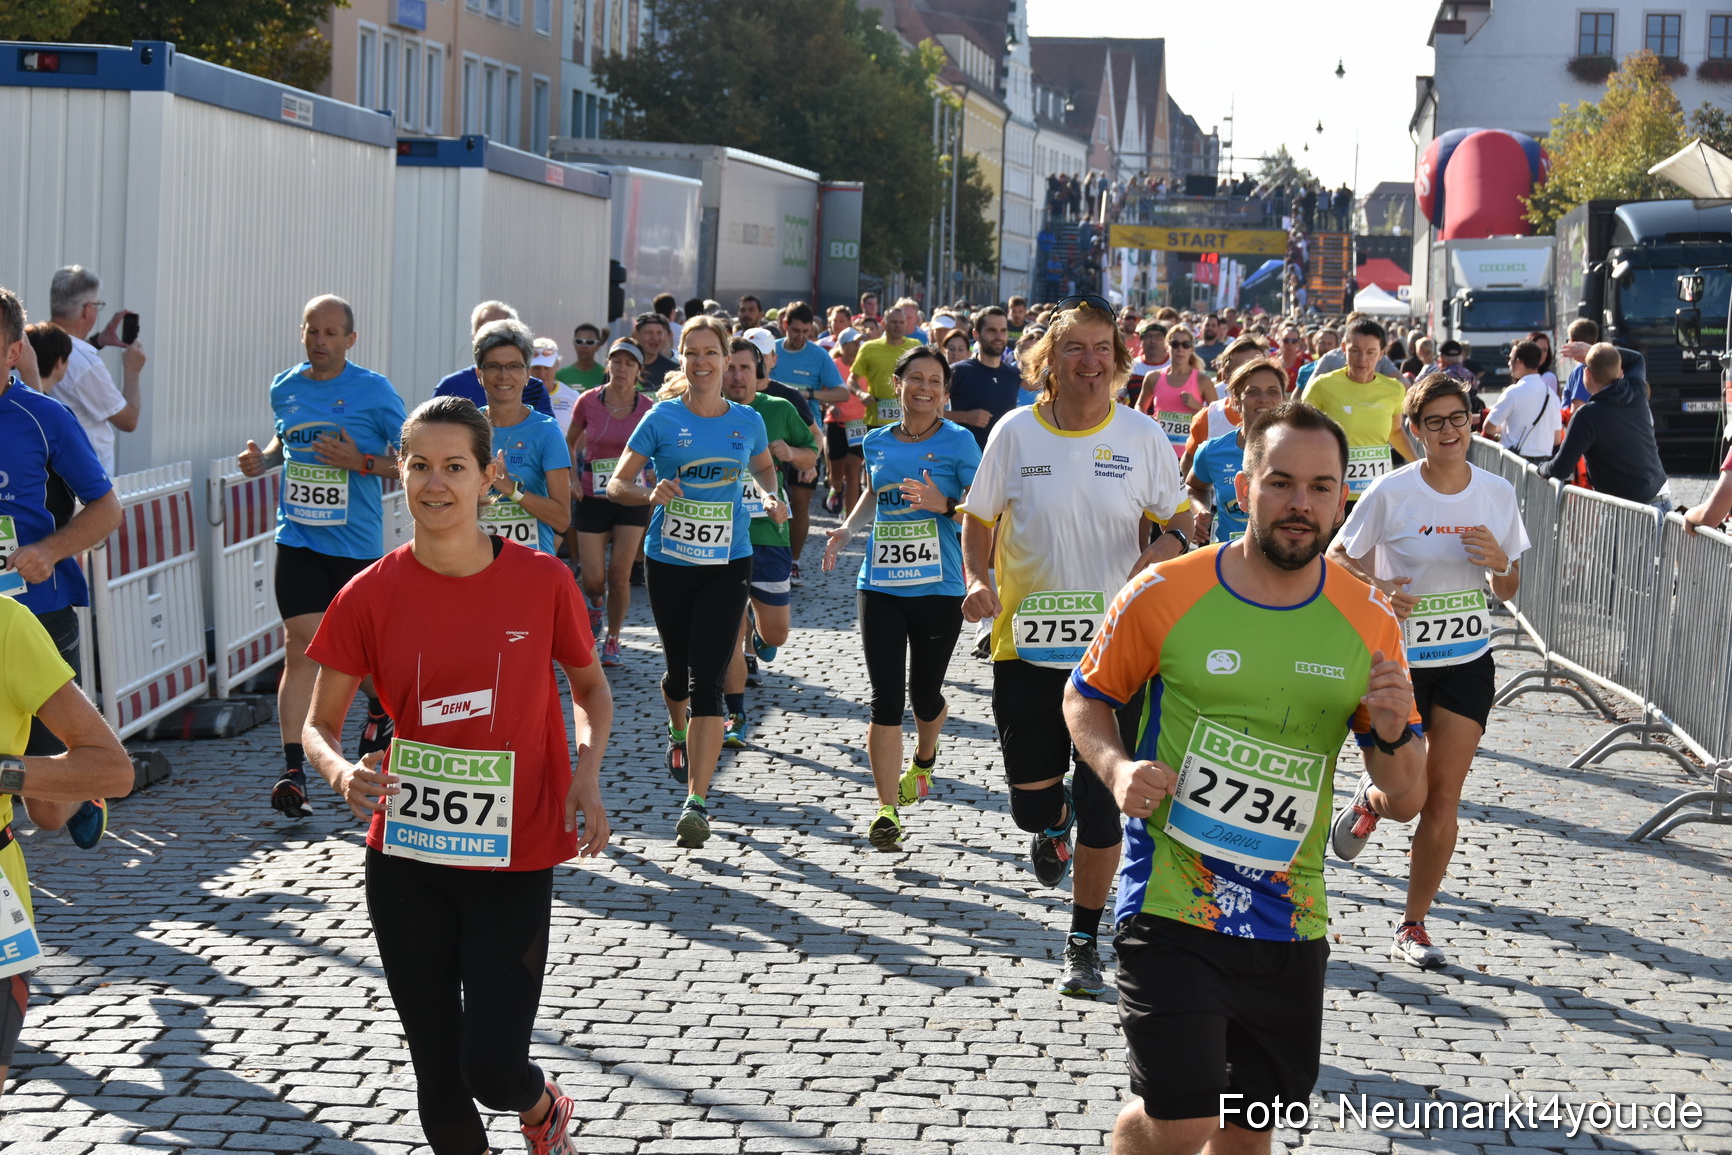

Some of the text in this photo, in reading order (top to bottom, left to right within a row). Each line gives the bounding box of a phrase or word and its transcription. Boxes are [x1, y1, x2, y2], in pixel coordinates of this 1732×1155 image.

[1167, 231, 1228, 249] START
[882, 408, 904, 419] 139
[1095, 448, 1112, 461] 20
[288, 464, 342, 483] BOCK
[1021, 465, 1051, 474] BOCK
[1094, 462, 1133, 472] Neumarkter
[1094, 470, 1126, 480] Stadtlauf
[1347, 462, 1385, 478] 2211
[290, 483, 340, 506] 2368
[293, 507, 334, 519] ROBERT
[671, 500, 728, 520] BOCK
[669, 519, 725, 543] 2367
[877, 522, 932, 540] BOCK
[676, 543, 715, 558] NICOLE
[878, 543, 932, 564] 2364
[888, 569, 922, 579] ILONA
[1020, 593, 1099, 613] BOCK
[1411, 591, 1483, 615] BOCK
[1023, 619, 1095, 643] 2752
[1415, 615, 1483, 643] 2720
[1418, 649, 1454, 660] NADINE
[1295, 661, 1346, 680] BOCK
[441, 700, 472, 716] DEHN
[397, 744, 502, 782] BOCK
[1199, 726, 1317, 787] BOCK
[399, 782, 495, 827] 2567
[1189, 767, 1298, 832] 2734
[396, 828, 496, 853] CHRISTINE
